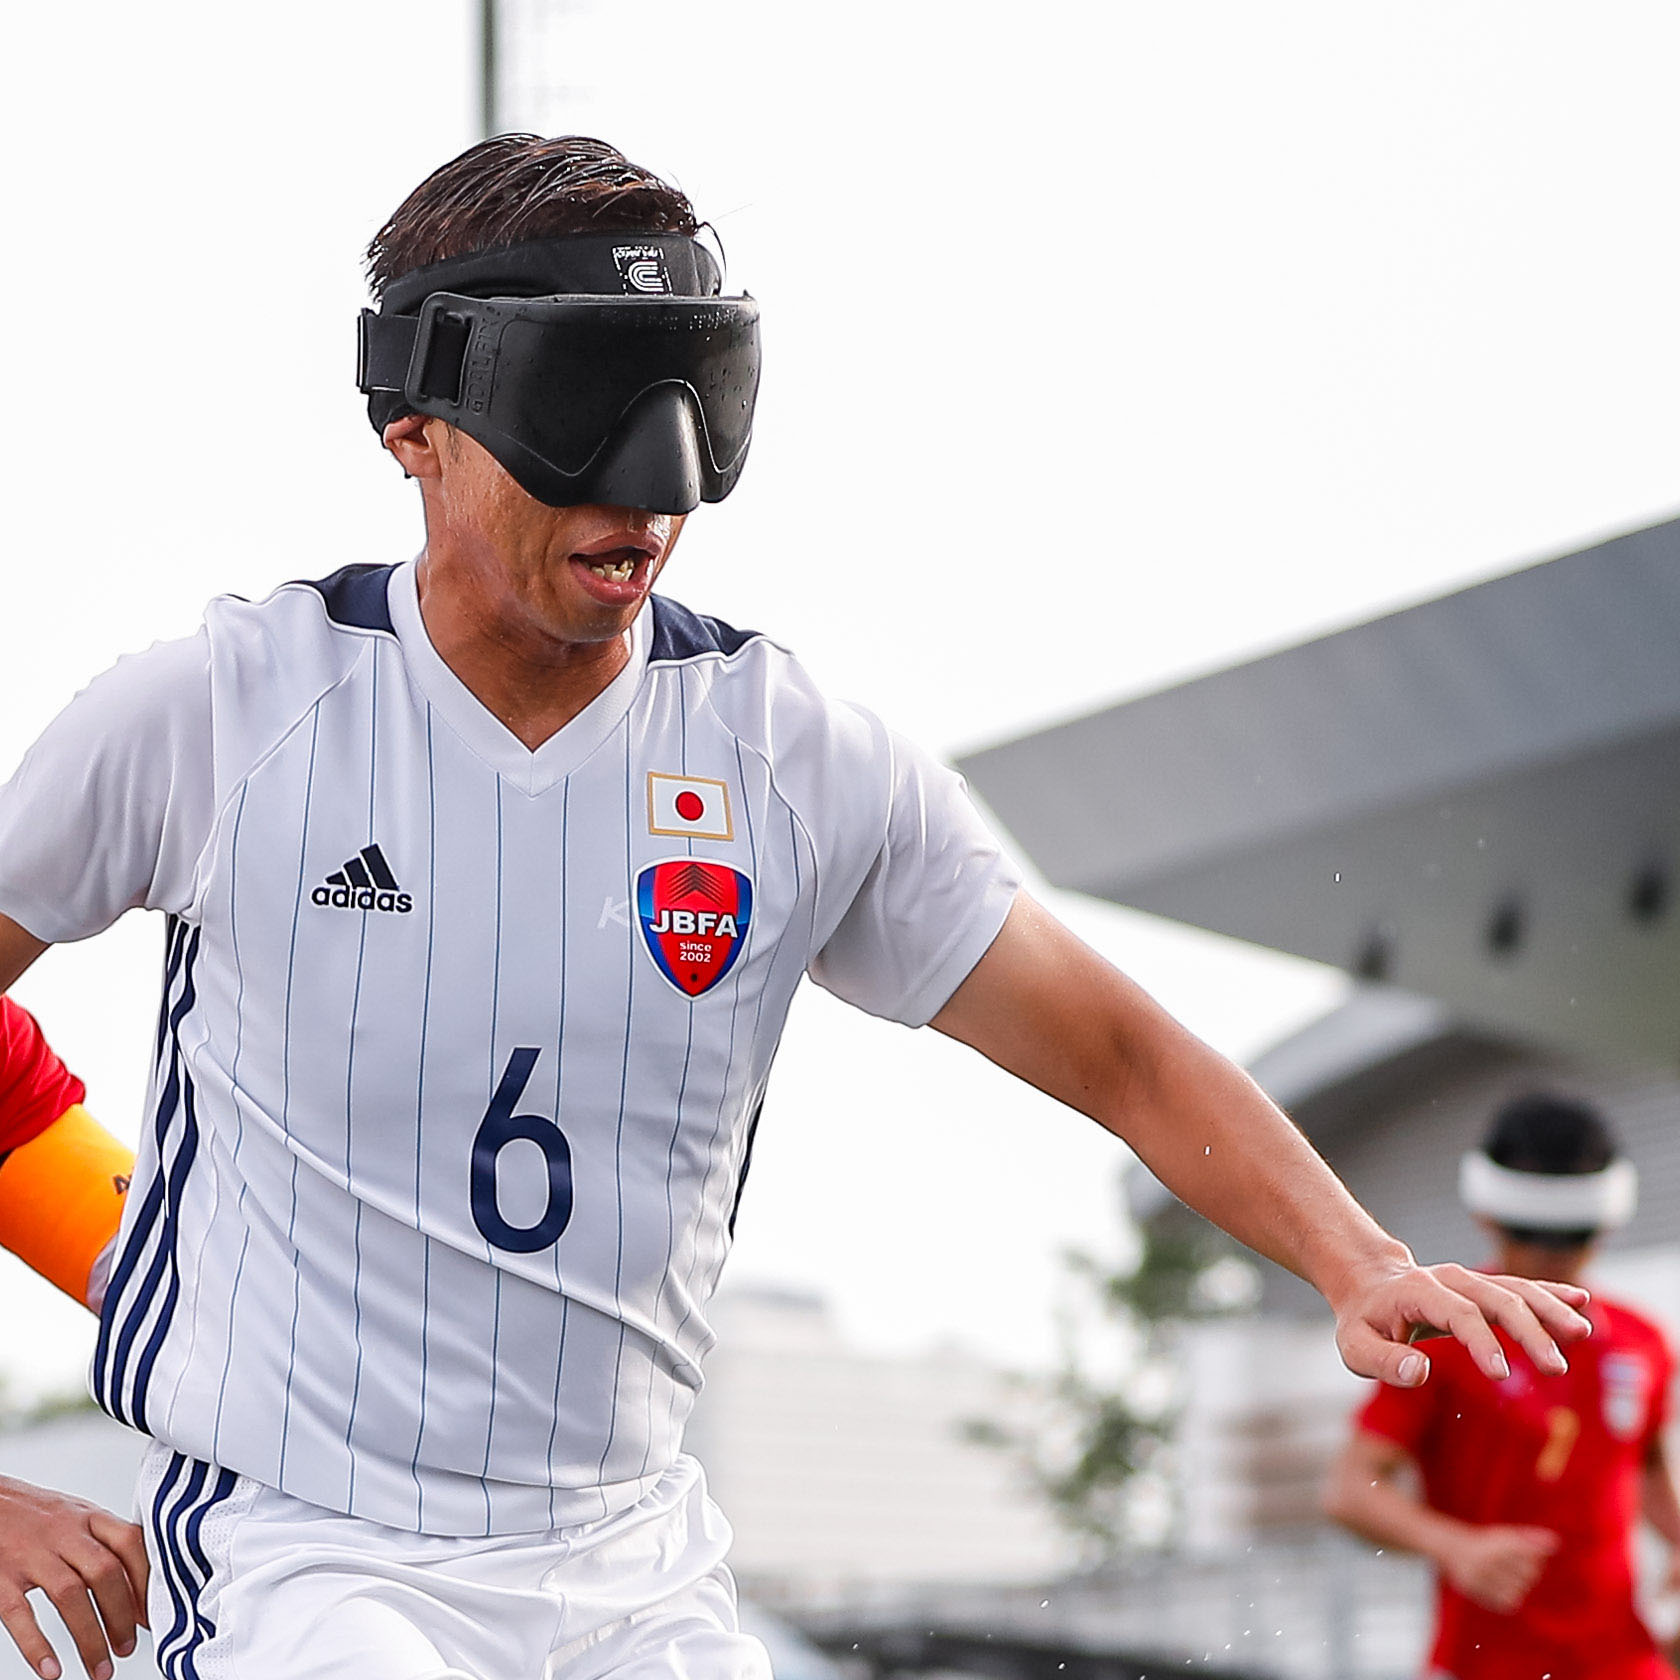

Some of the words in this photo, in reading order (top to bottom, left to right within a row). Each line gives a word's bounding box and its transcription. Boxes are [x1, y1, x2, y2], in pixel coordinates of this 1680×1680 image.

[310, 884, 413, 913] adidas
[649, 909, 739, 939] JBFA
[679, 940, 712, 952] since
[679, 951, 712, 963] 2002
[470, 1047, 574, 1254] 6
